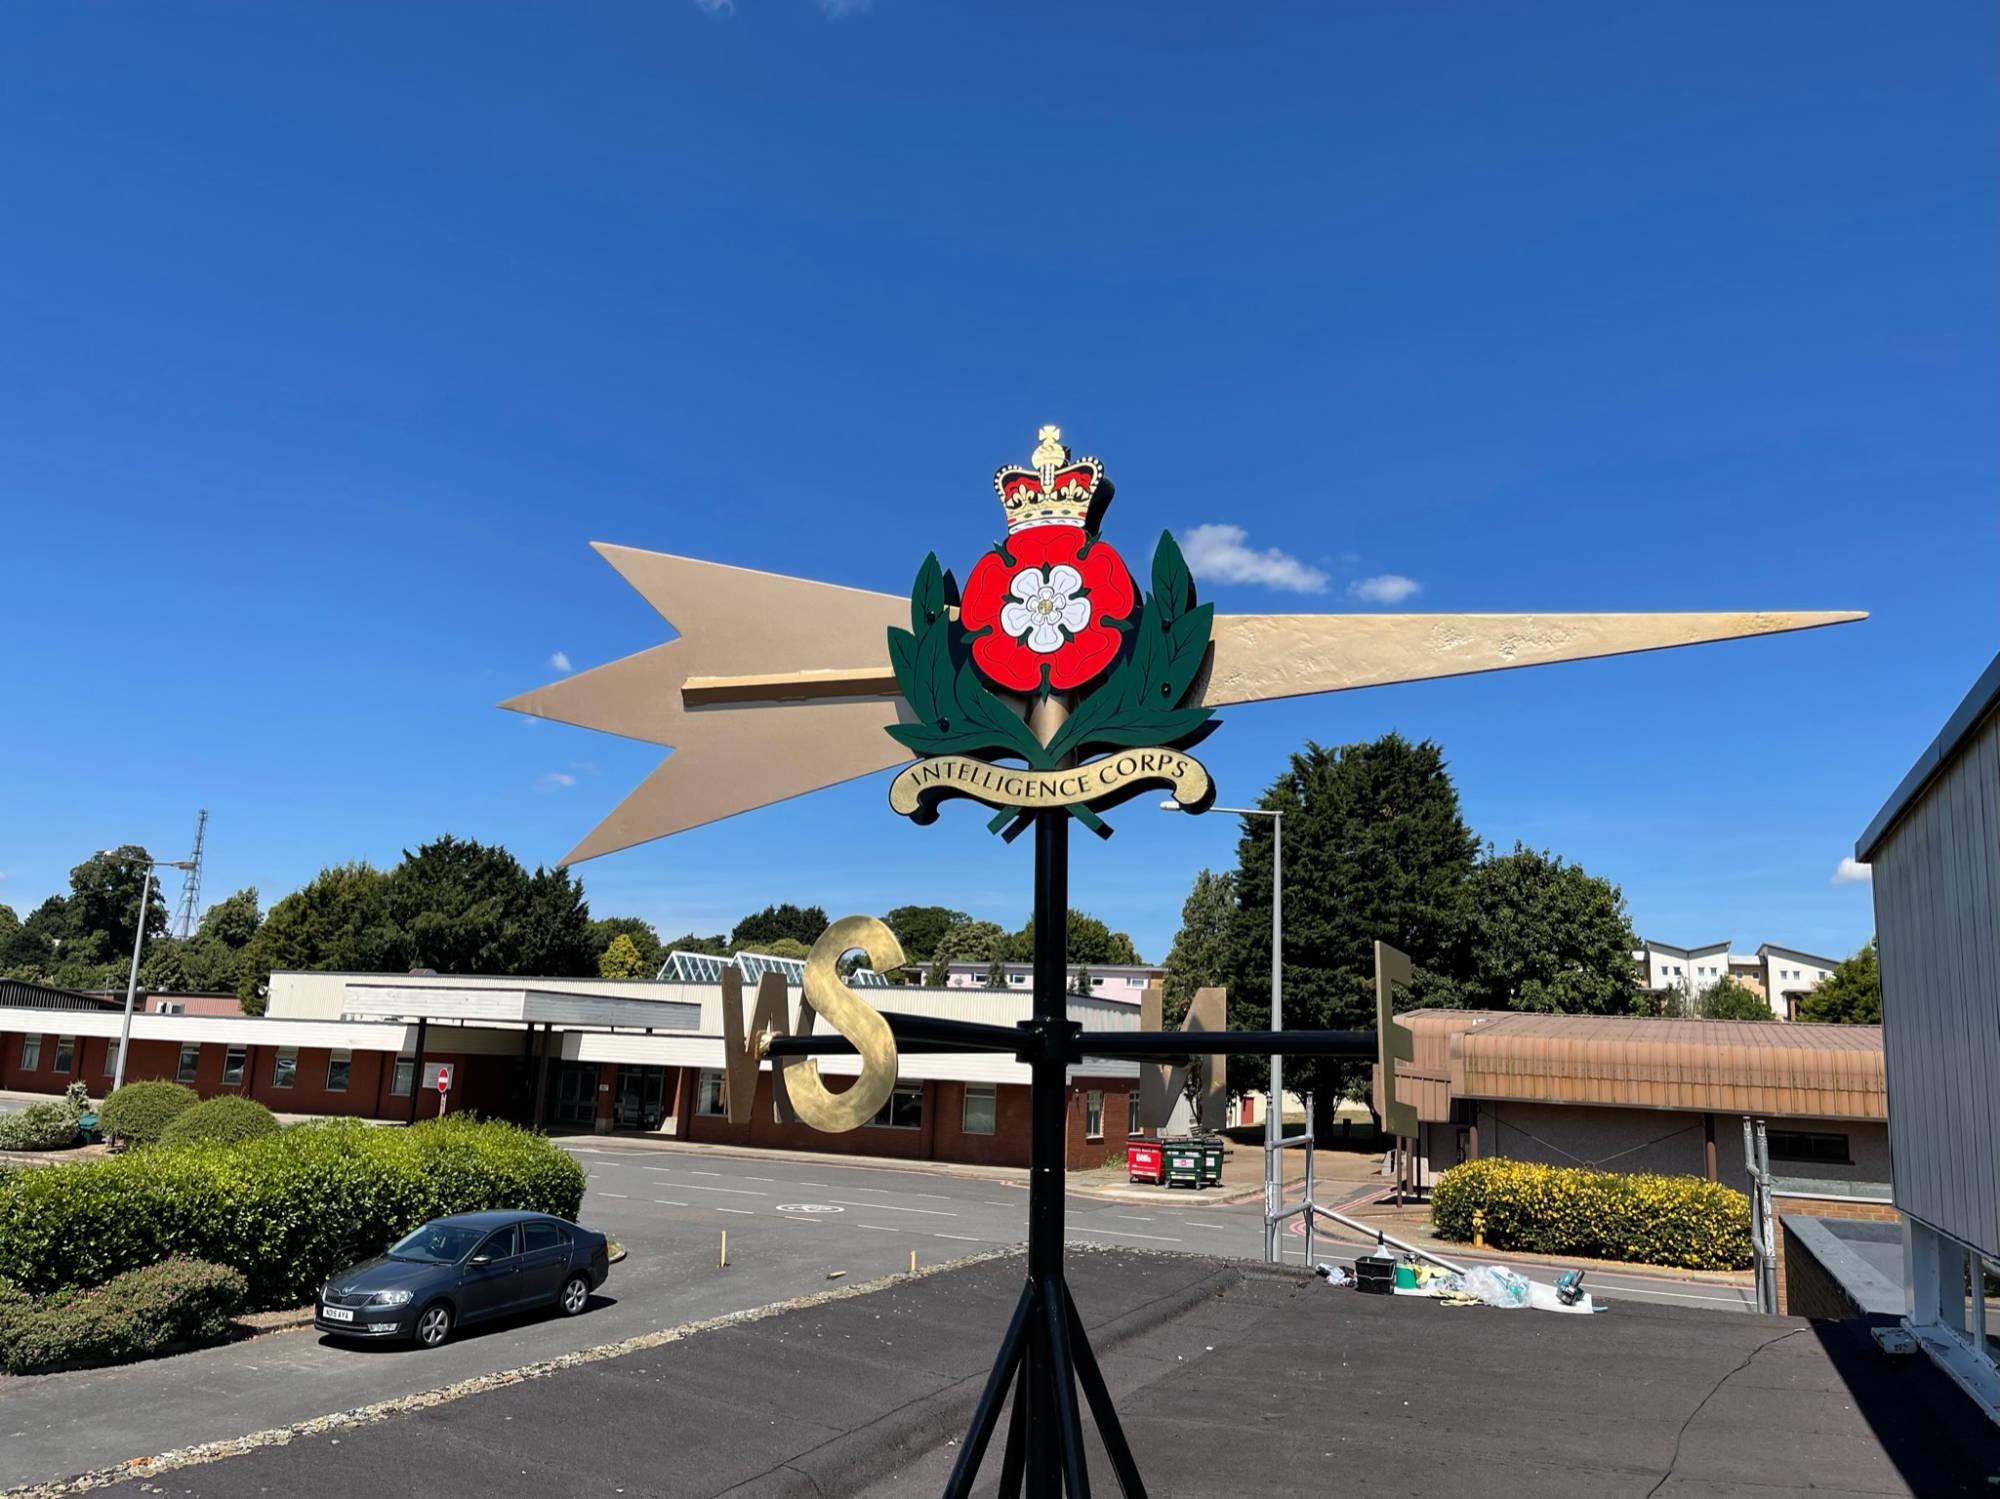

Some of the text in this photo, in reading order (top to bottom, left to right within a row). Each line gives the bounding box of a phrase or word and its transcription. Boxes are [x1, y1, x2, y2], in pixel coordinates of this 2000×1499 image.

[911, 753, 1189, 799] INTELLIGENCE CORPS
[783, 914, 907, 1134] S
[1374, 939, 1419, 1140] E
